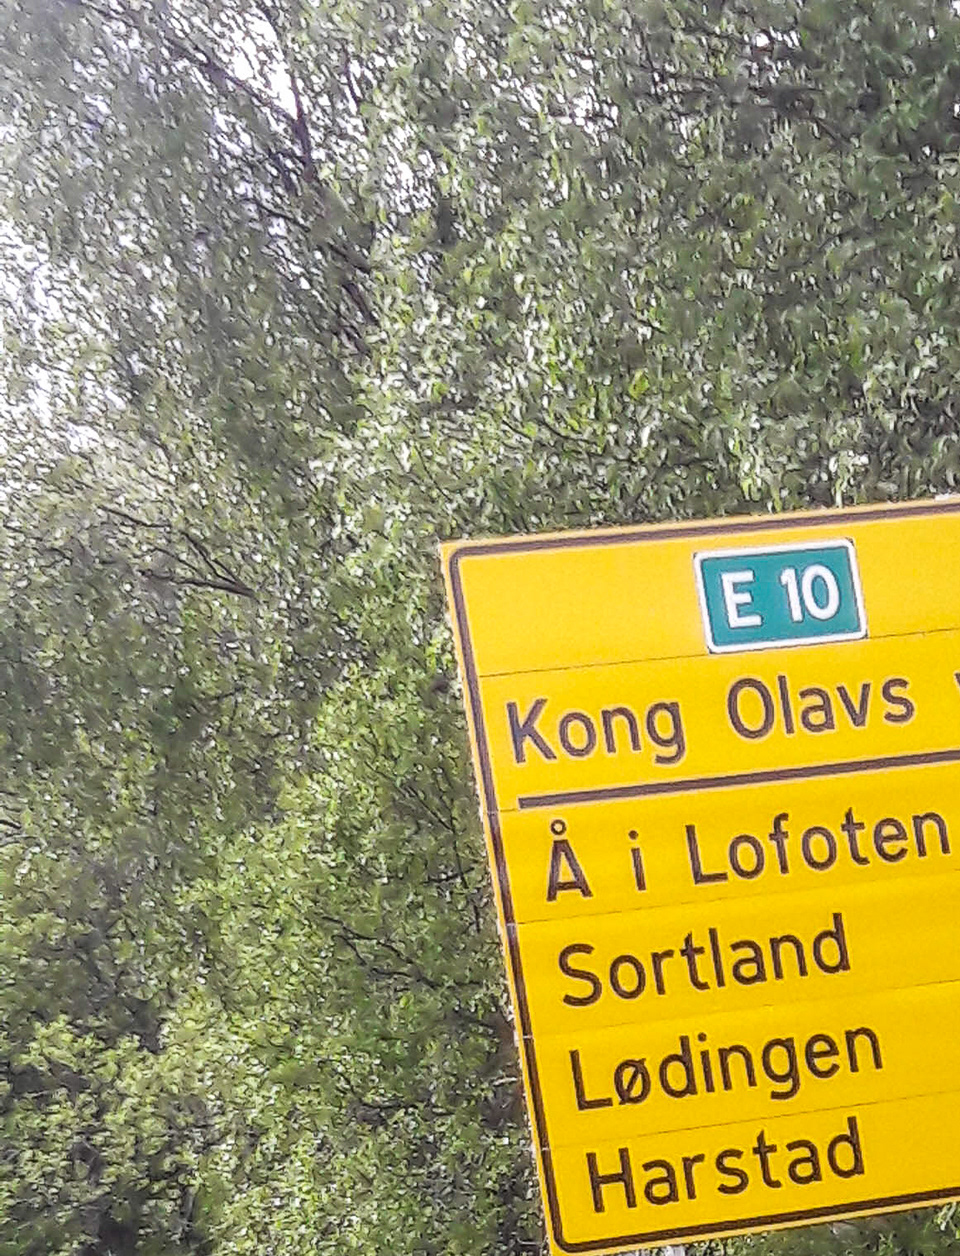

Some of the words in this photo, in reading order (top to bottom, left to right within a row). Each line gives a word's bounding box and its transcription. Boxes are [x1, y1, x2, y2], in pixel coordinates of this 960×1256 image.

[720, 570, 763, 629] E
[780, 563, 841, 621] 10
[505, 696, 687, 764] Kong
[727, 673, 916, 740] Olavs
[546, 820, 593, 903] Å
[629, 829, 648, 892] i
[685, 806, 952, 886] Lofoten
[557, 912, 853, 1008] Sortland
[568, 1022, 884, 1113] Lødingen
[585, 1115, 866, 1214] Harstad
